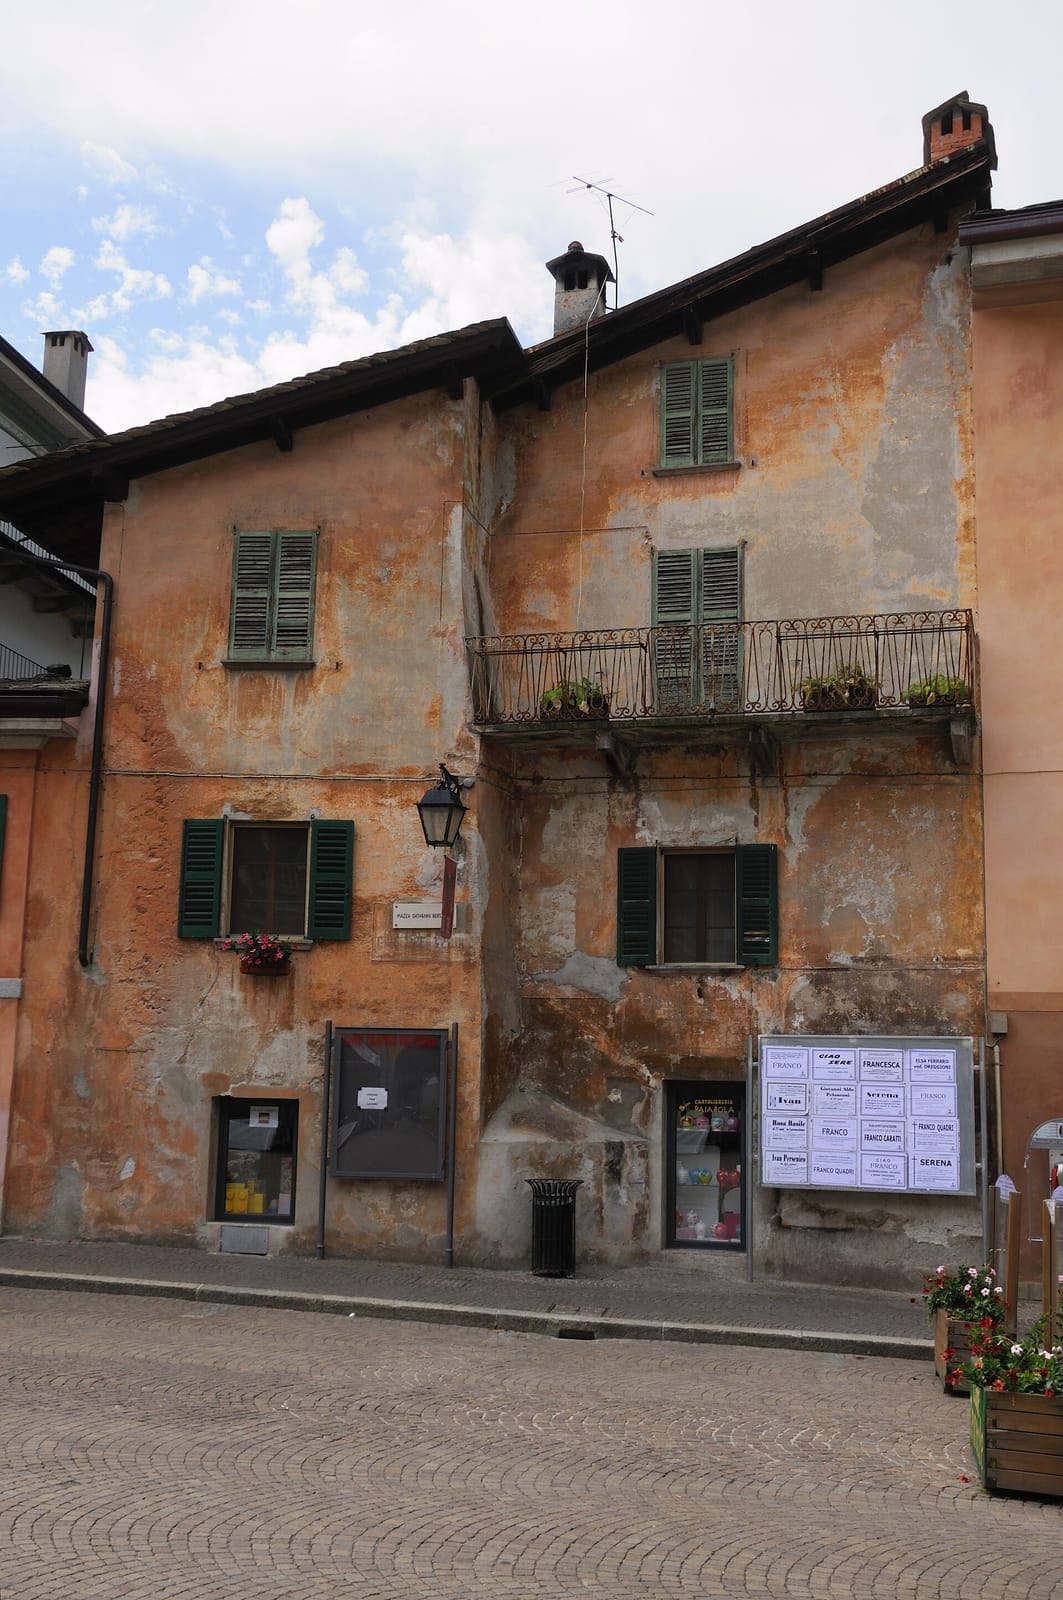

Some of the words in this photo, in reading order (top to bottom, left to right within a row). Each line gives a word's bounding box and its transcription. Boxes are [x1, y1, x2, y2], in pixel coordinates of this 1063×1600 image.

[863, 1060, 900, 1068] FRANCESCA
[778, 1096, 801, 1104] Ivan
[918, 1123, 936, 1131] FRANCO
[937, 1124, 955, 1132] QUADRI
[822, 1128, 848, 1136] FRANCO
[863, 1134, 882, 1142] FRANCO
[772, 1153, 782, 1161] Ivan
[920, 1159, 953, 1167] SERENA
[813, 1166, 834, 1174] FRANCO
[834, 1167, 855, 1175] QUADRI
